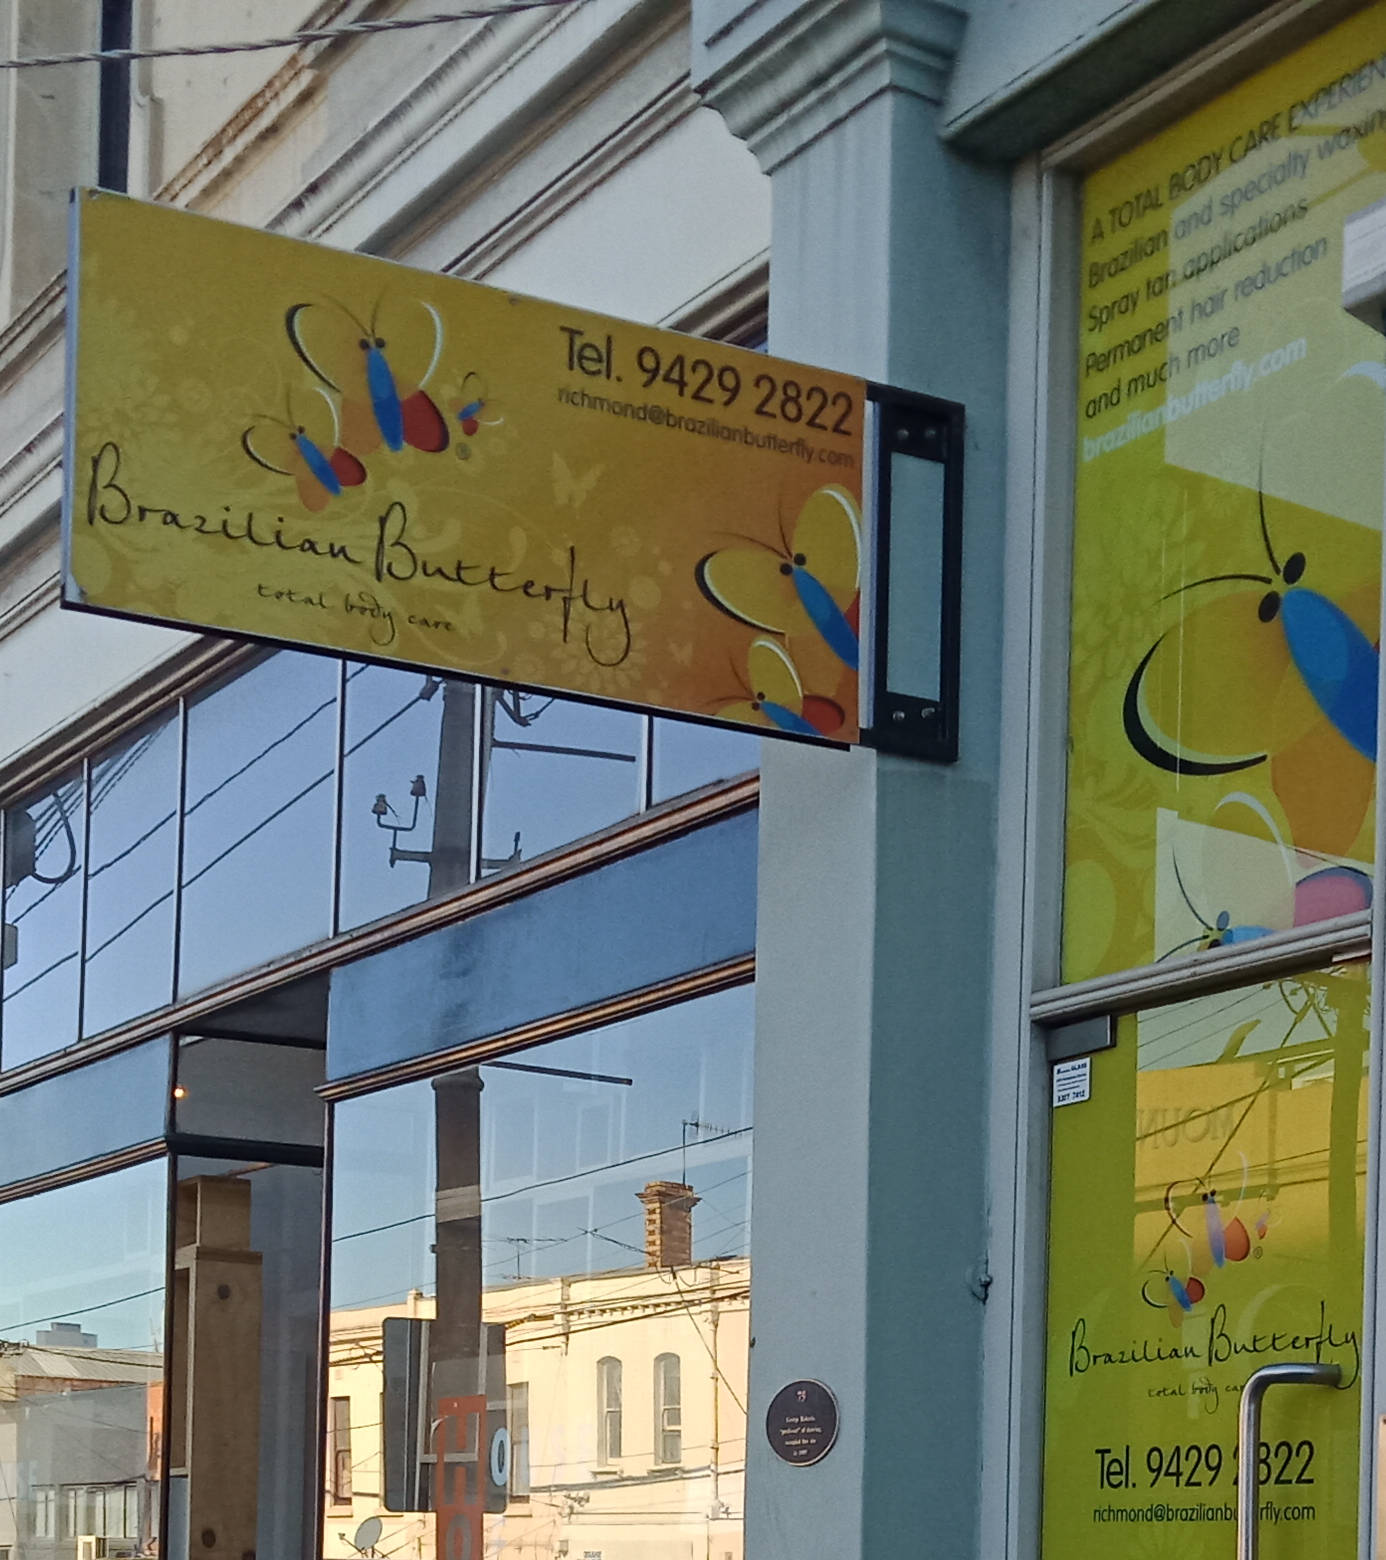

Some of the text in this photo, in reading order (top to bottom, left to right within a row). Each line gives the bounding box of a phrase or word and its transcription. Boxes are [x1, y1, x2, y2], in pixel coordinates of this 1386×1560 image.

[1090, 218, 1105, 244] A
[1108, 186, 1162, 234] TOTAL
[1169, 151, 1224, 201] BODY
[1229, 114, 1281, 165] CARE
[1088, 228, 1169, 288] Brazilian
[1174, 198, 1213, 241] and
[1088, 286, 1141, 333] Spray
[1146, 267, 1176, 300] tan
[1183, 199, 1310, 286] applications
[1085, 308, 1184, 378] Permanent
[1190, 287, 1228, 325] hair
[1234, 236, 1328, 300] reduction
[559, 326, 853, 436] Tel. 9429 2822
[1085, 326, 1241, 419] and much more
[558, 387, 854, 468] richmond@brazilianbutterfly.com
[88, 442, 631, 667] Brazilian Butterfly
[258, 583, 453, 646] total body care
[1070, 1301, 1359, 1390] Brazilian Butterfly
[1148, 1384, 1185, 1398] total
[1191, 1376, 1219, 1414] body
[1095, 1440, 1314, 1489] Tel. 9429 822
